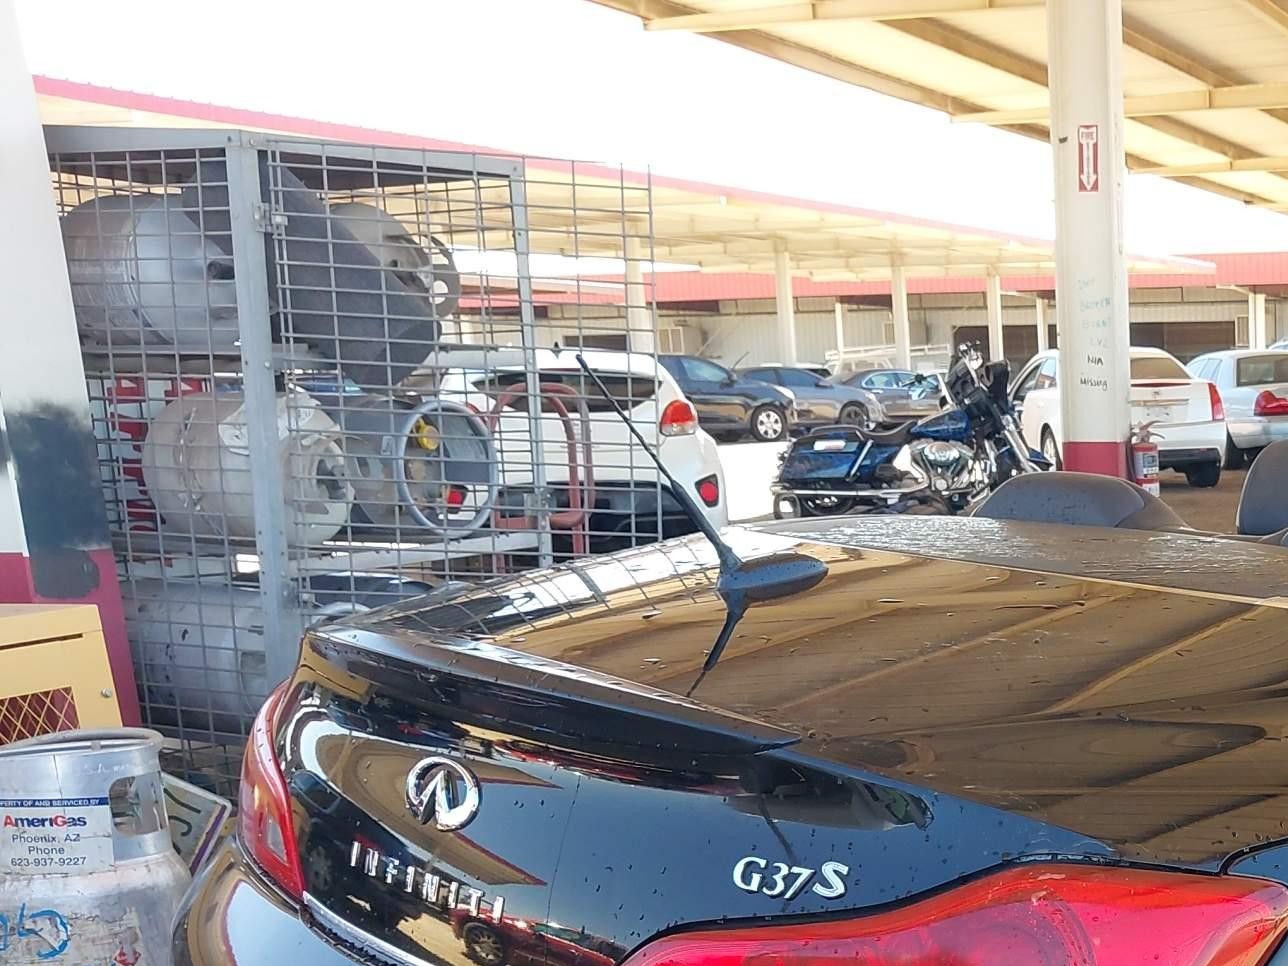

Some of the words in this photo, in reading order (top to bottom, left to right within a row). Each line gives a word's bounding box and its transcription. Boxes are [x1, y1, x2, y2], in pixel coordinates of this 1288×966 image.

[4, 815, 87, 828] AmeriGas
[28, 846, 65, 855] Phone
[11, 857, 86, 867] 623-937-9227
[351, 841, 505, 924] INFINITI
